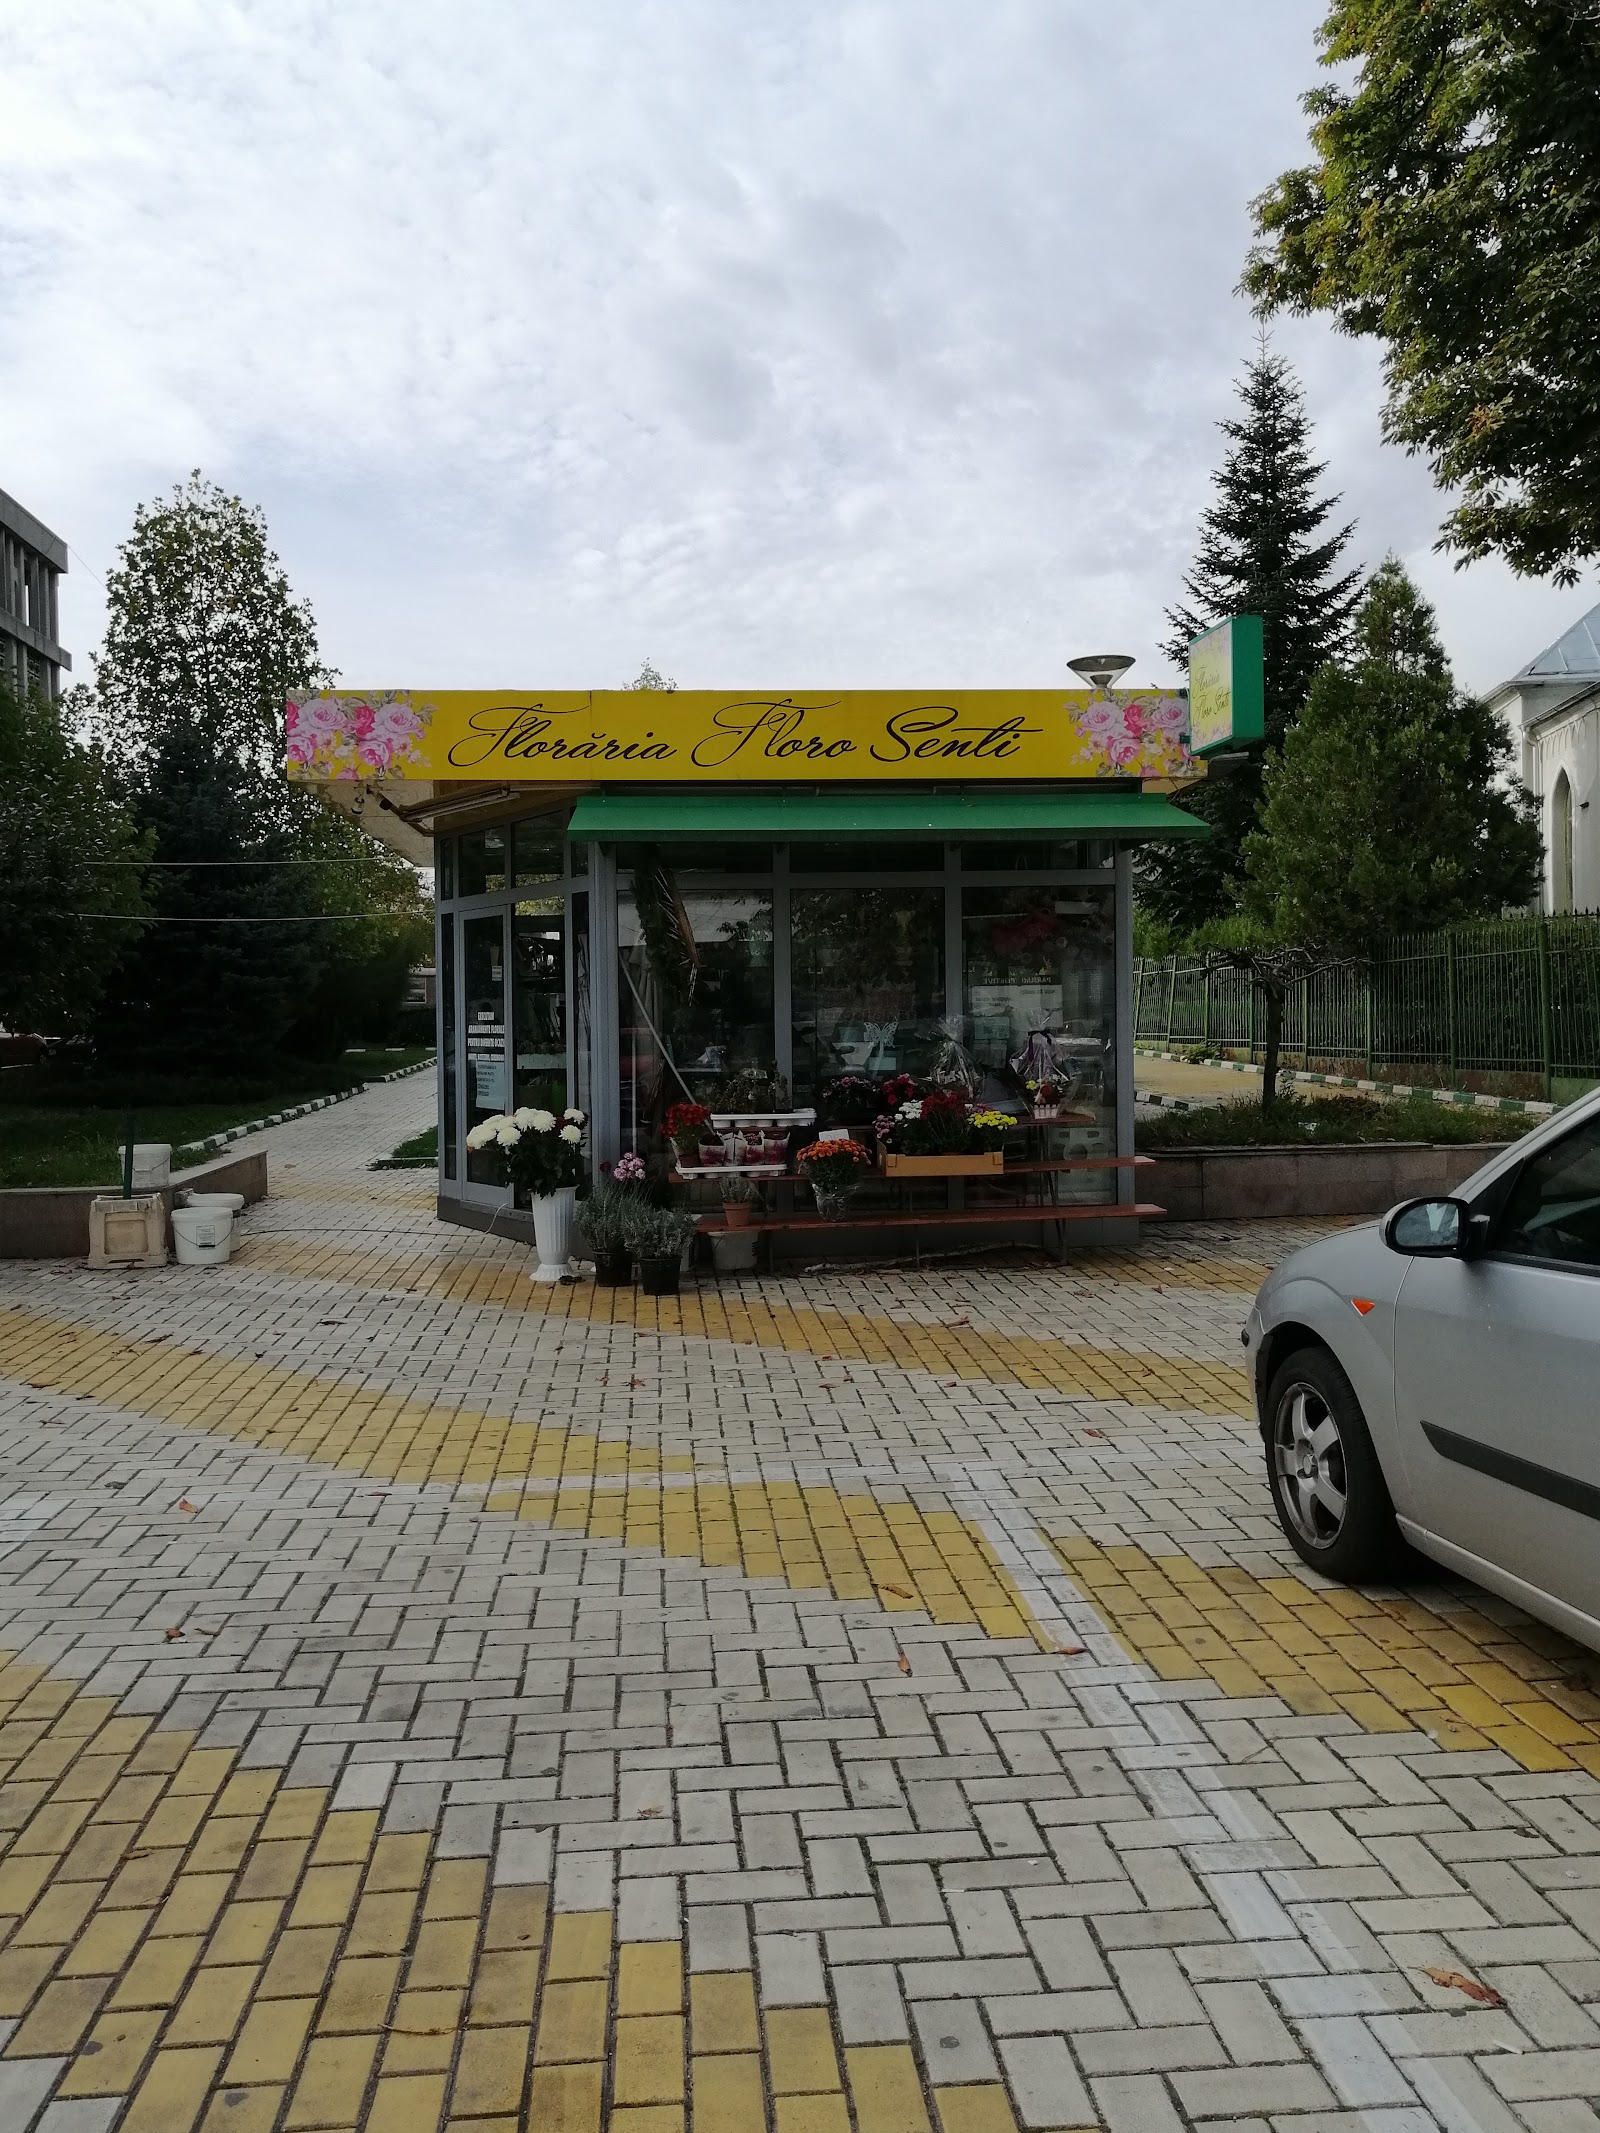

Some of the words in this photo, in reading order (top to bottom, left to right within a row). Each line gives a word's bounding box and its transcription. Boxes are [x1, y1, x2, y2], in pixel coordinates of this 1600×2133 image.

[448, 702, 678, 768] Florăria
[691, 698, 858, 768] Floro
[869, 706, 1044, 763] Senti
